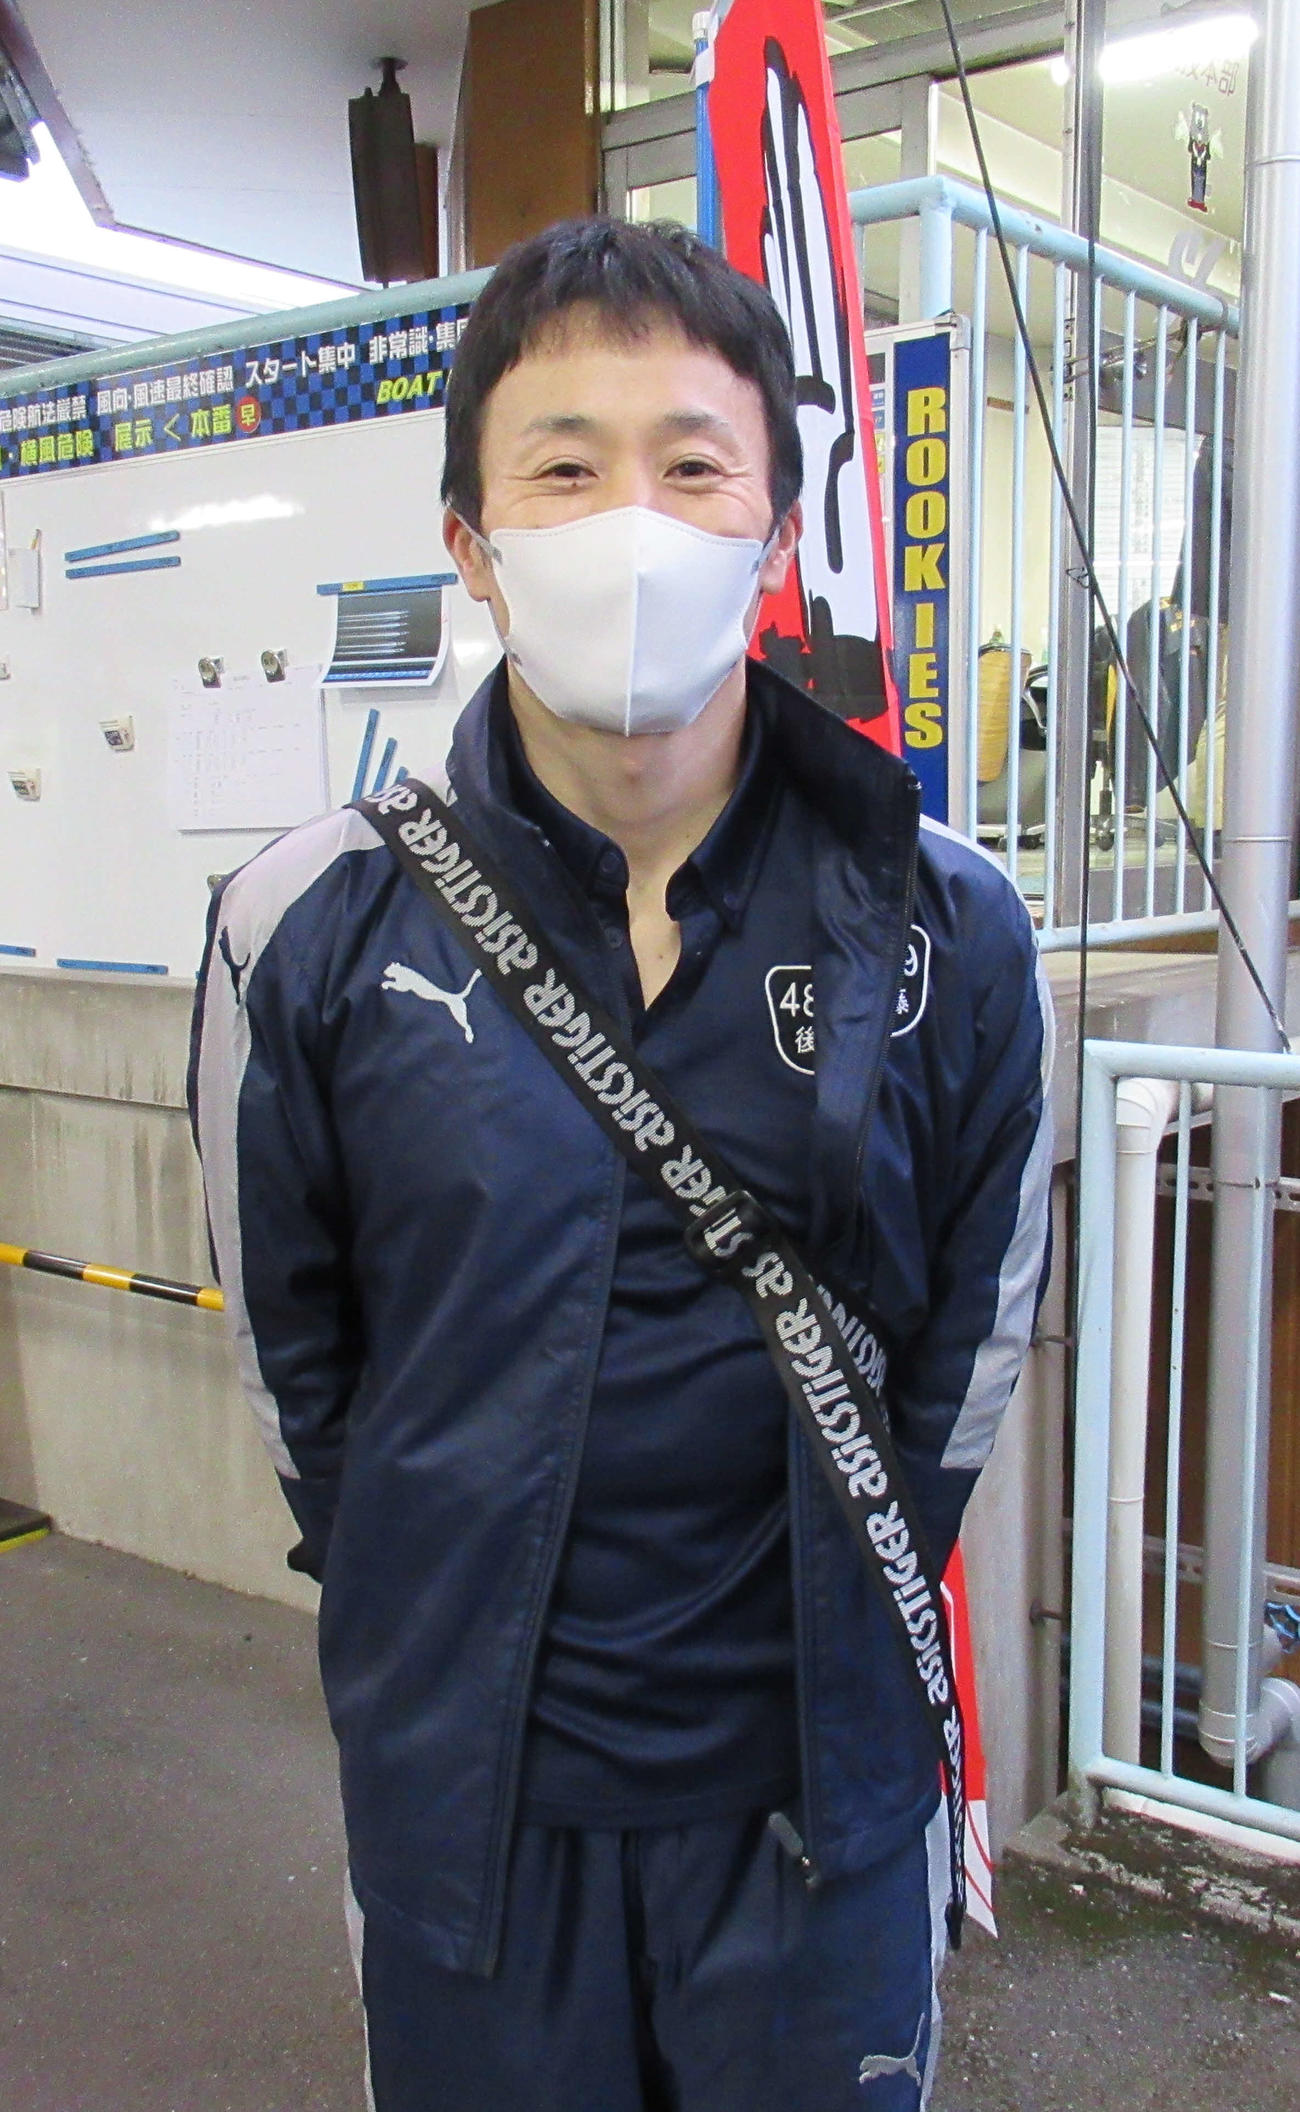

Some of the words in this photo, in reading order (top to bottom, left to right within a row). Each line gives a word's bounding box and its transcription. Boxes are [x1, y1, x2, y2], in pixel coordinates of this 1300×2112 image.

[245, 341, 355, 388] スタート集中
[376, 371, 443, 405] BOAT
[188, 403, 232, 438] 本番
[904, 386, 947, 749] ROOKIES
